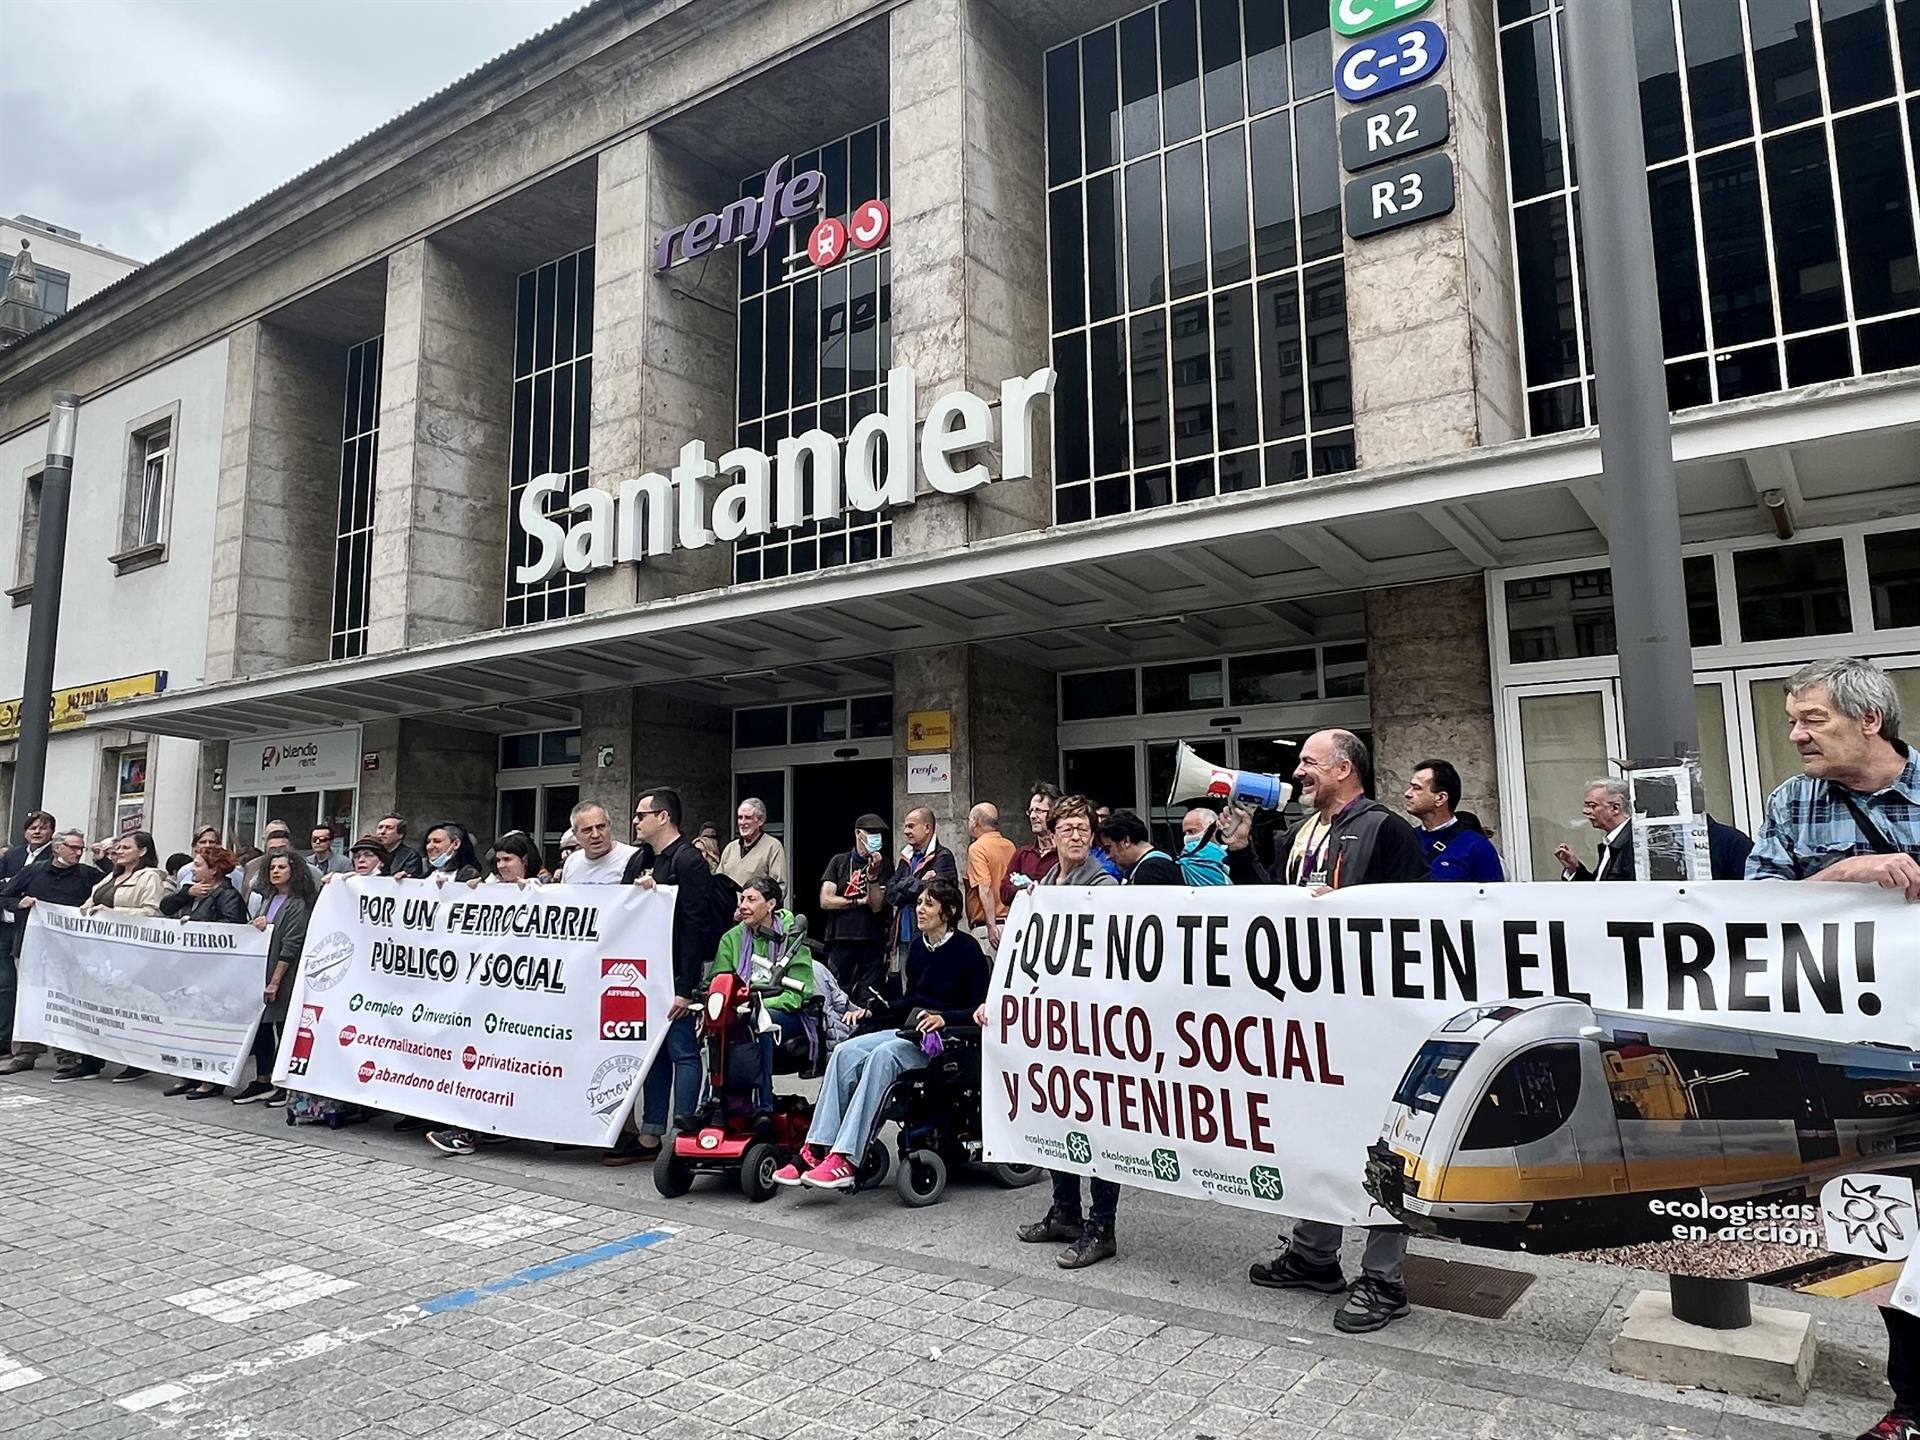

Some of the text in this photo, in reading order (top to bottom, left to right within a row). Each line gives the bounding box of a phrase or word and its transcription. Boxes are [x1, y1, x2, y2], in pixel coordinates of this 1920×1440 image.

[1343, 30, 1429, 91] C-3
[1367, 104, 1419, 152] R2
[657, 154, 825, 271] renfe
[1371, 172, 1424, 219] R3
[516, 366, 1057, 585] Santander
[911, 763, 938, 776] renfe
[140, 927, 175, 945] BILBAO
[183, 932, 237, 949] FERROL
[359, 895, 599, 941] POR UN FERROCARRIL
[370, 937, 459, 982] PÚBLICO
[466, 952, 482, 983] Y
[480, 952, 566, 993] SOCIAL
[1004, 911, 1883, 1017] ¡QUE NO TE QUITEN EL TREN!
[365, 1000, 573, 1041] empleo inversión frecuencias
[603, 1020, 644, 1039] CGT
[1000, 985, 1345, 1086] PÚBLICO, SOCIAL
[289, 1057, 308, 1074] GT
[357, 1032, 453, 1061] externalizaciones
[477, 1053, 563, 1079] privatización
[375, 1068, 434, 1090] abandono
[437, 1079, 453, 1095] del
[455, 1083, 515, 1107] ferrocarril
[1001, 1062, 1276, 1154] y SOSTENIBLE
[1024, 1133, 1065, 1150] ecoloxistes
[1101, 1150, 1152, 1167] ekologistak
[1114, 1162, 1154, 1178] martxan
[1193, 1167, 1248, 1186] ecoloxistas
[1202, 1179, 1251, 1197] en acción
[1648, 1198, 1816, 1226] ecologistas
[1672, 1221, 1819, 1248] en acción
